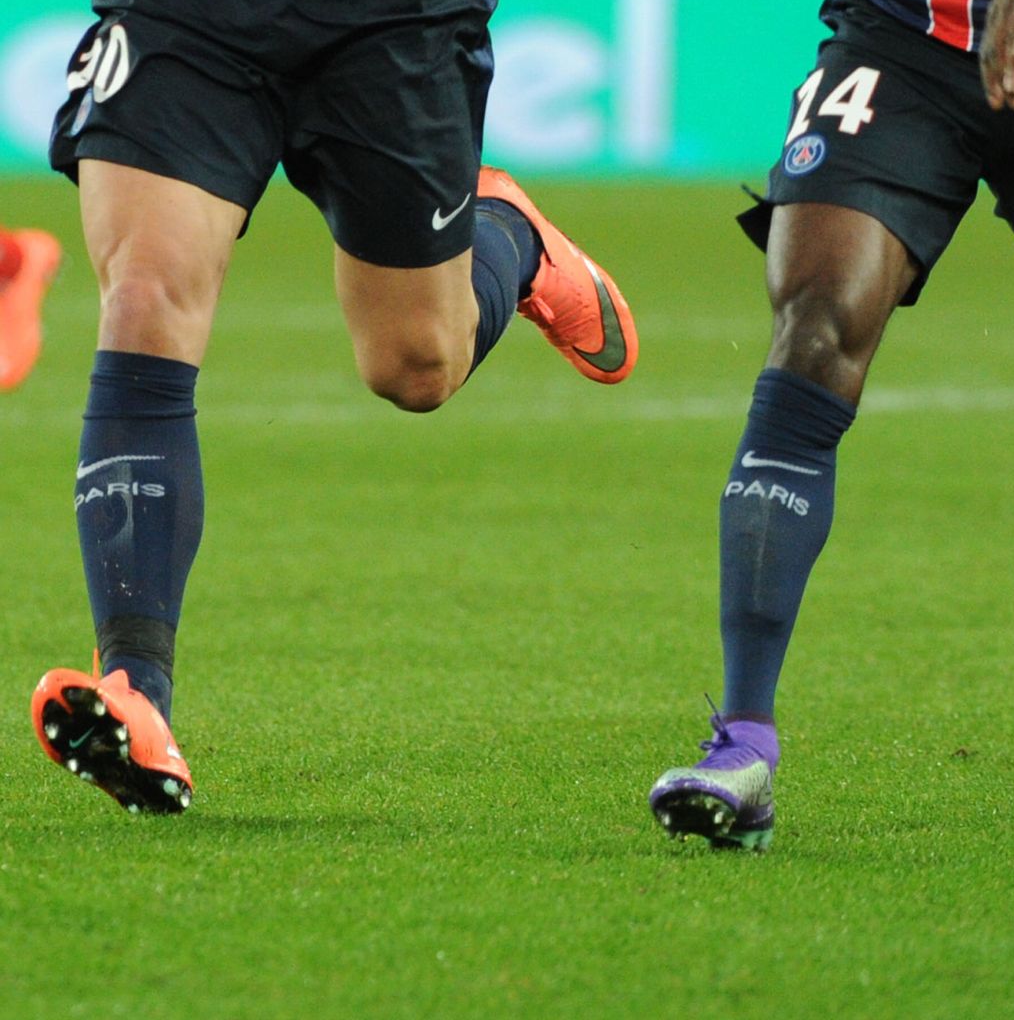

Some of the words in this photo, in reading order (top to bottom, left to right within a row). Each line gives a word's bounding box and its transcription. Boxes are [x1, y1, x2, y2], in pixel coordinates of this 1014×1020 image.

[784, 66, 881, 147] 14
[74, 481, 165, 512] PARIS
[724, 479, 810, 516] PARIS
